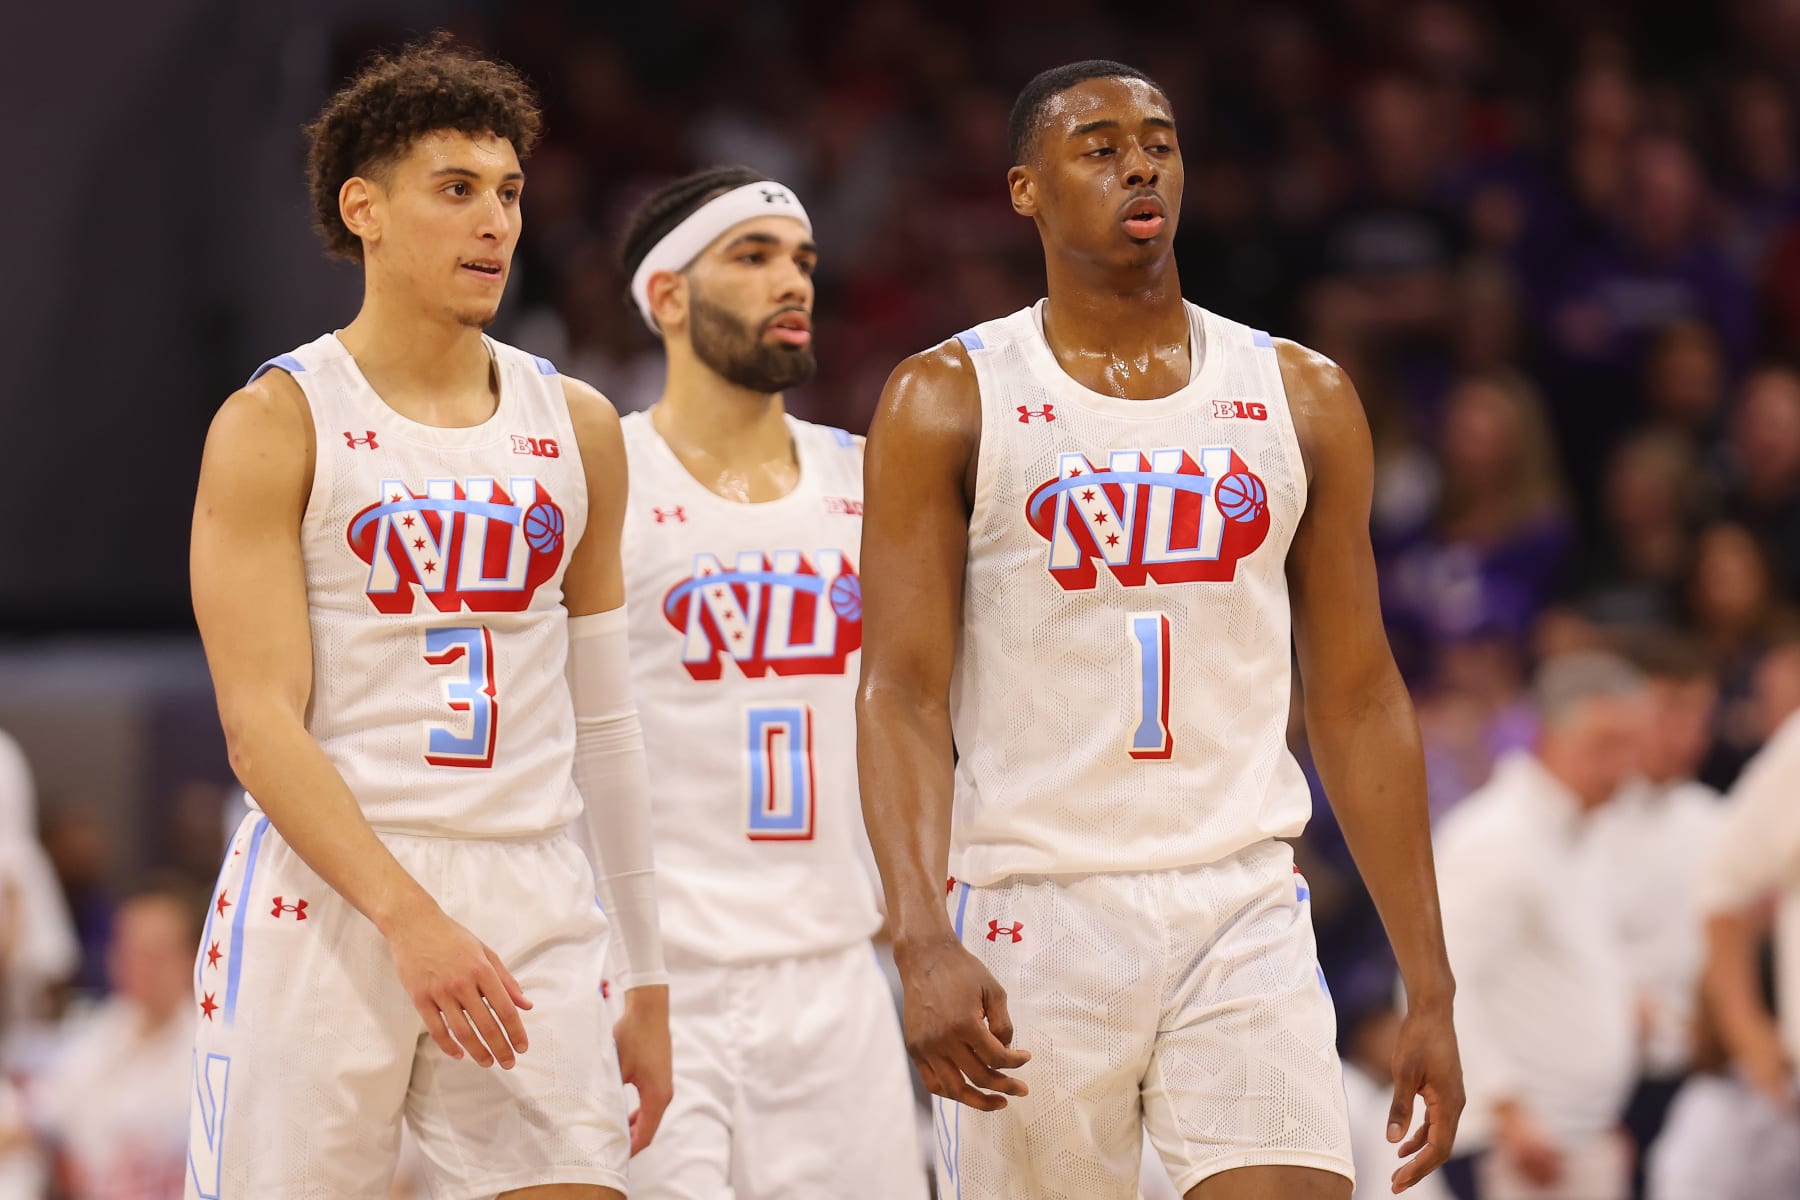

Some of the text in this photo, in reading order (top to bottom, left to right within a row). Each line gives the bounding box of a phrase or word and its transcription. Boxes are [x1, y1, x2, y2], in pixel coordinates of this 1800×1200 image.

[365, 476, 548, 614] NU
[1047, 446, 1249, 591] NU
[681, 548, 855, 681] NU
[422, 624, 498, 769] 3
[1126, 611, 1174, 761] 1
[744, 702, 816, 842] 0
